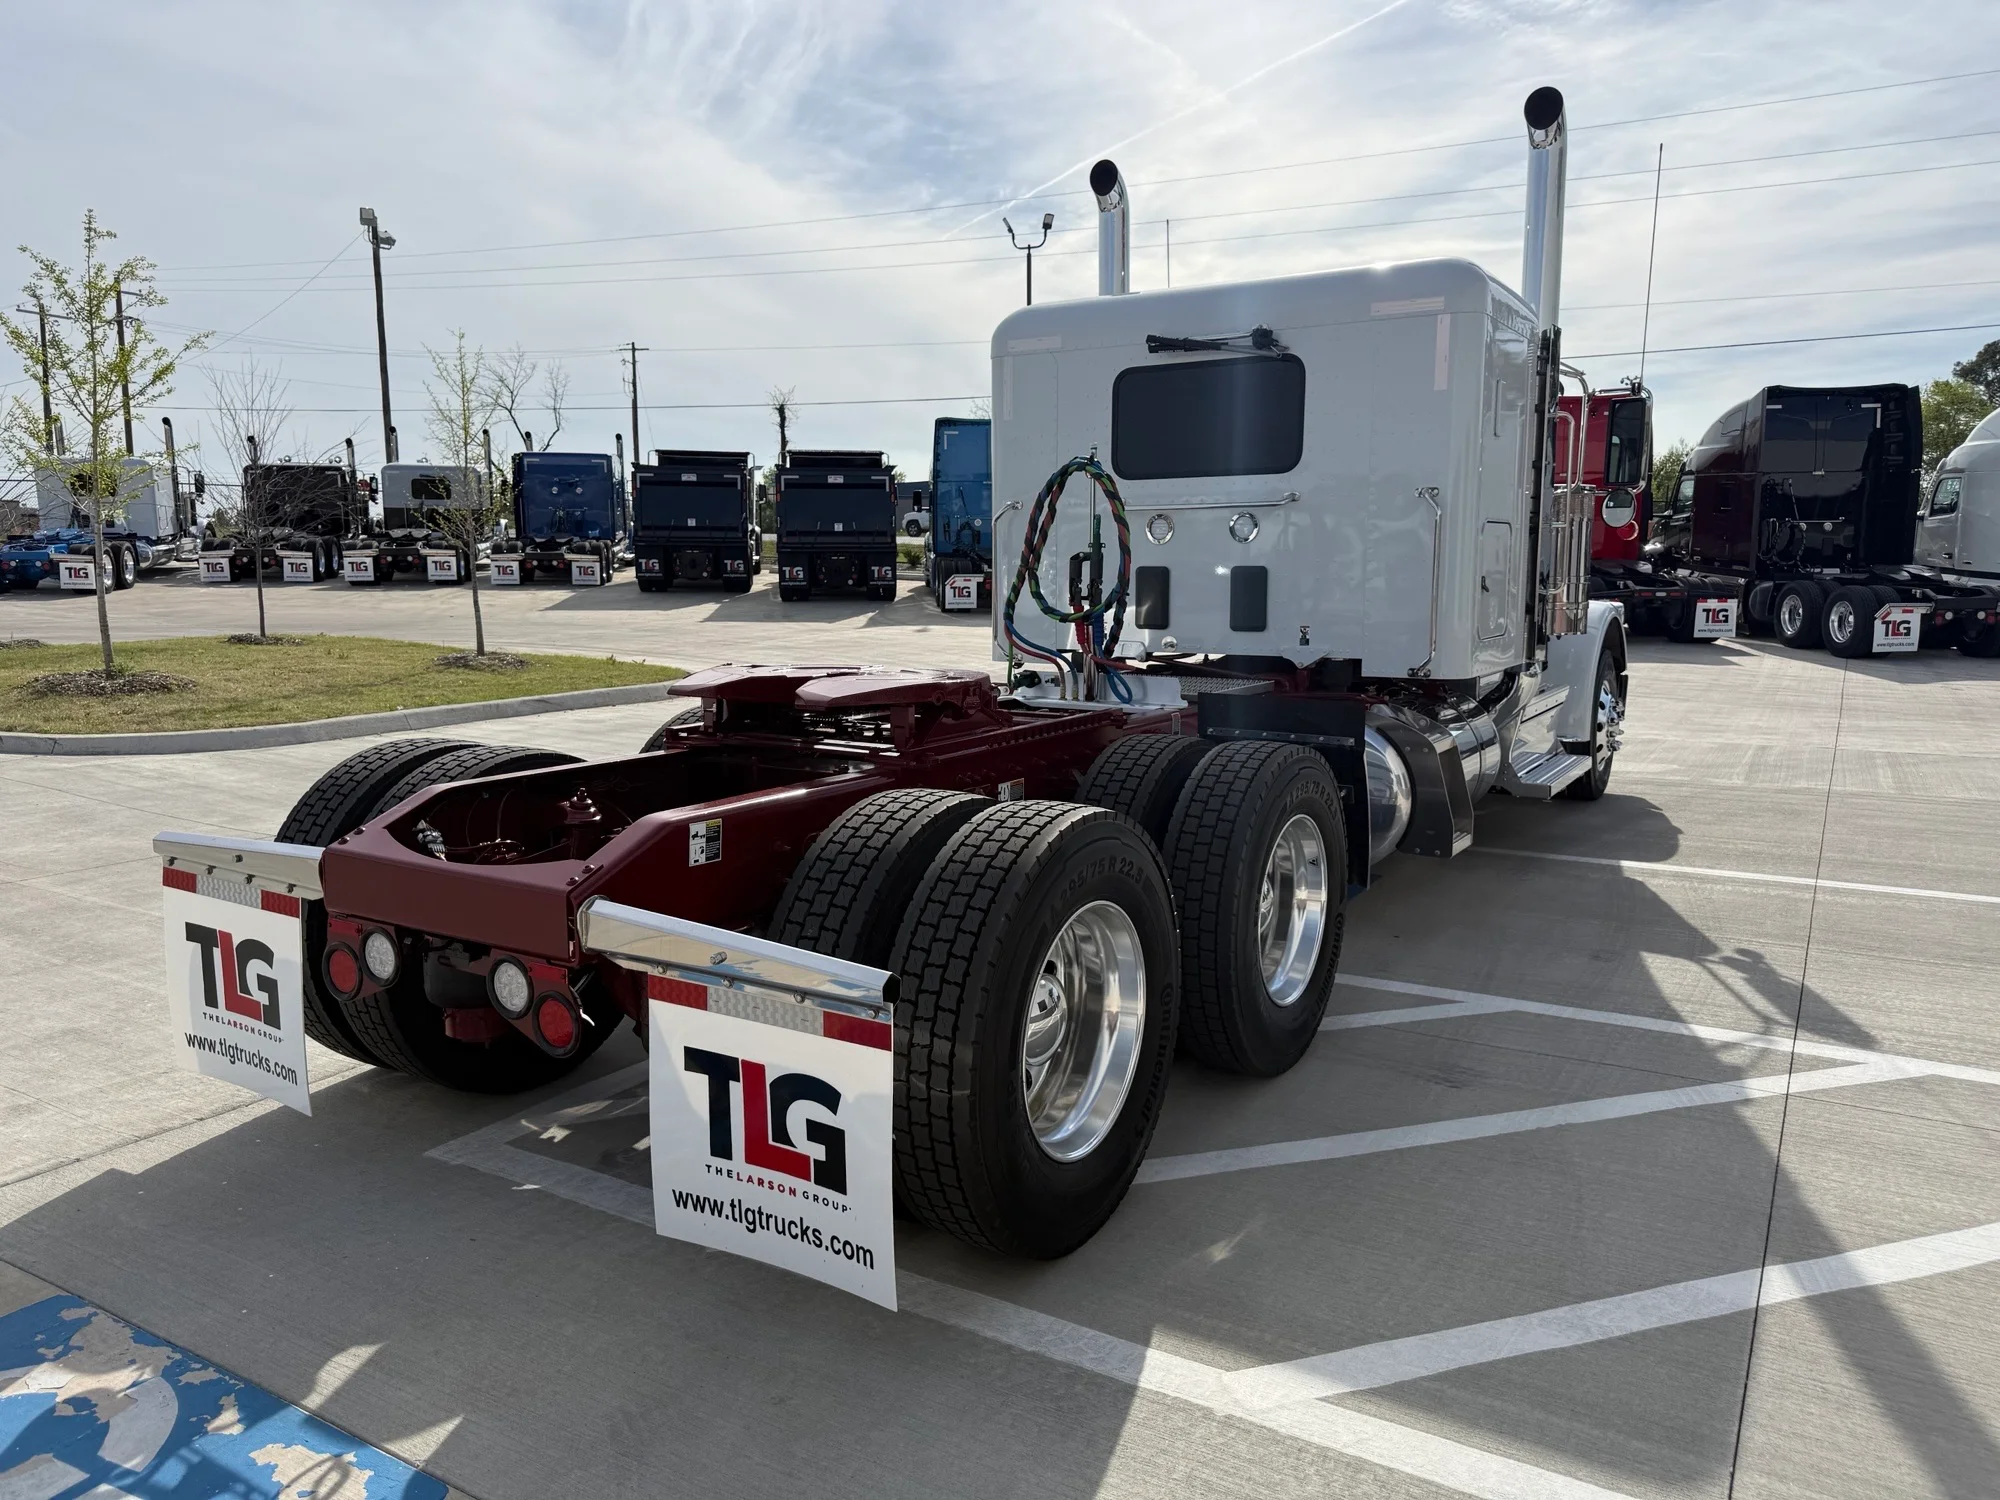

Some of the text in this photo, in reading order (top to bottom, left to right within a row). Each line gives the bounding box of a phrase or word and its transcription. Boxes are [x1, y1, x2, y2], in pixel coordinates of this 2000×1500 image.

[204, 562, 224, 573] TLG
[288, 562, 308, 573] TLG
[348, 561, 368, 572] TLG
[432, 560, 451, 571] TLG
[494, 565, 515, 576] TLG
[576, 565, 595, 576] TLG
[638, 559, 660, 570] TLG
[724, 559, 744, 571] TLG
[65, 566, 89, 579] TLG
[782, 566, 804, 579] TLG
[871, 566, 892, 578] TLG
[950, 586, 971, 598] TLG
[1702, 608, 1729, 624] TLG
[1881, 619, 1911, 637] TLG
[1108, 854, 1117, 872] R
[1118, 856, 1144, 884] 22.5
[185, 921, 281, 1030] TLG
[257, 1029, 282, 1044] GROUP
[184, 1031, 298, 1086] www.tlgtrucks.com
[683, 1045, 848, 1196] TLG
[802, 1190, 849, 1213] GROUP
[671, 1189, 874, 1270] www.tlgtrucks.com
